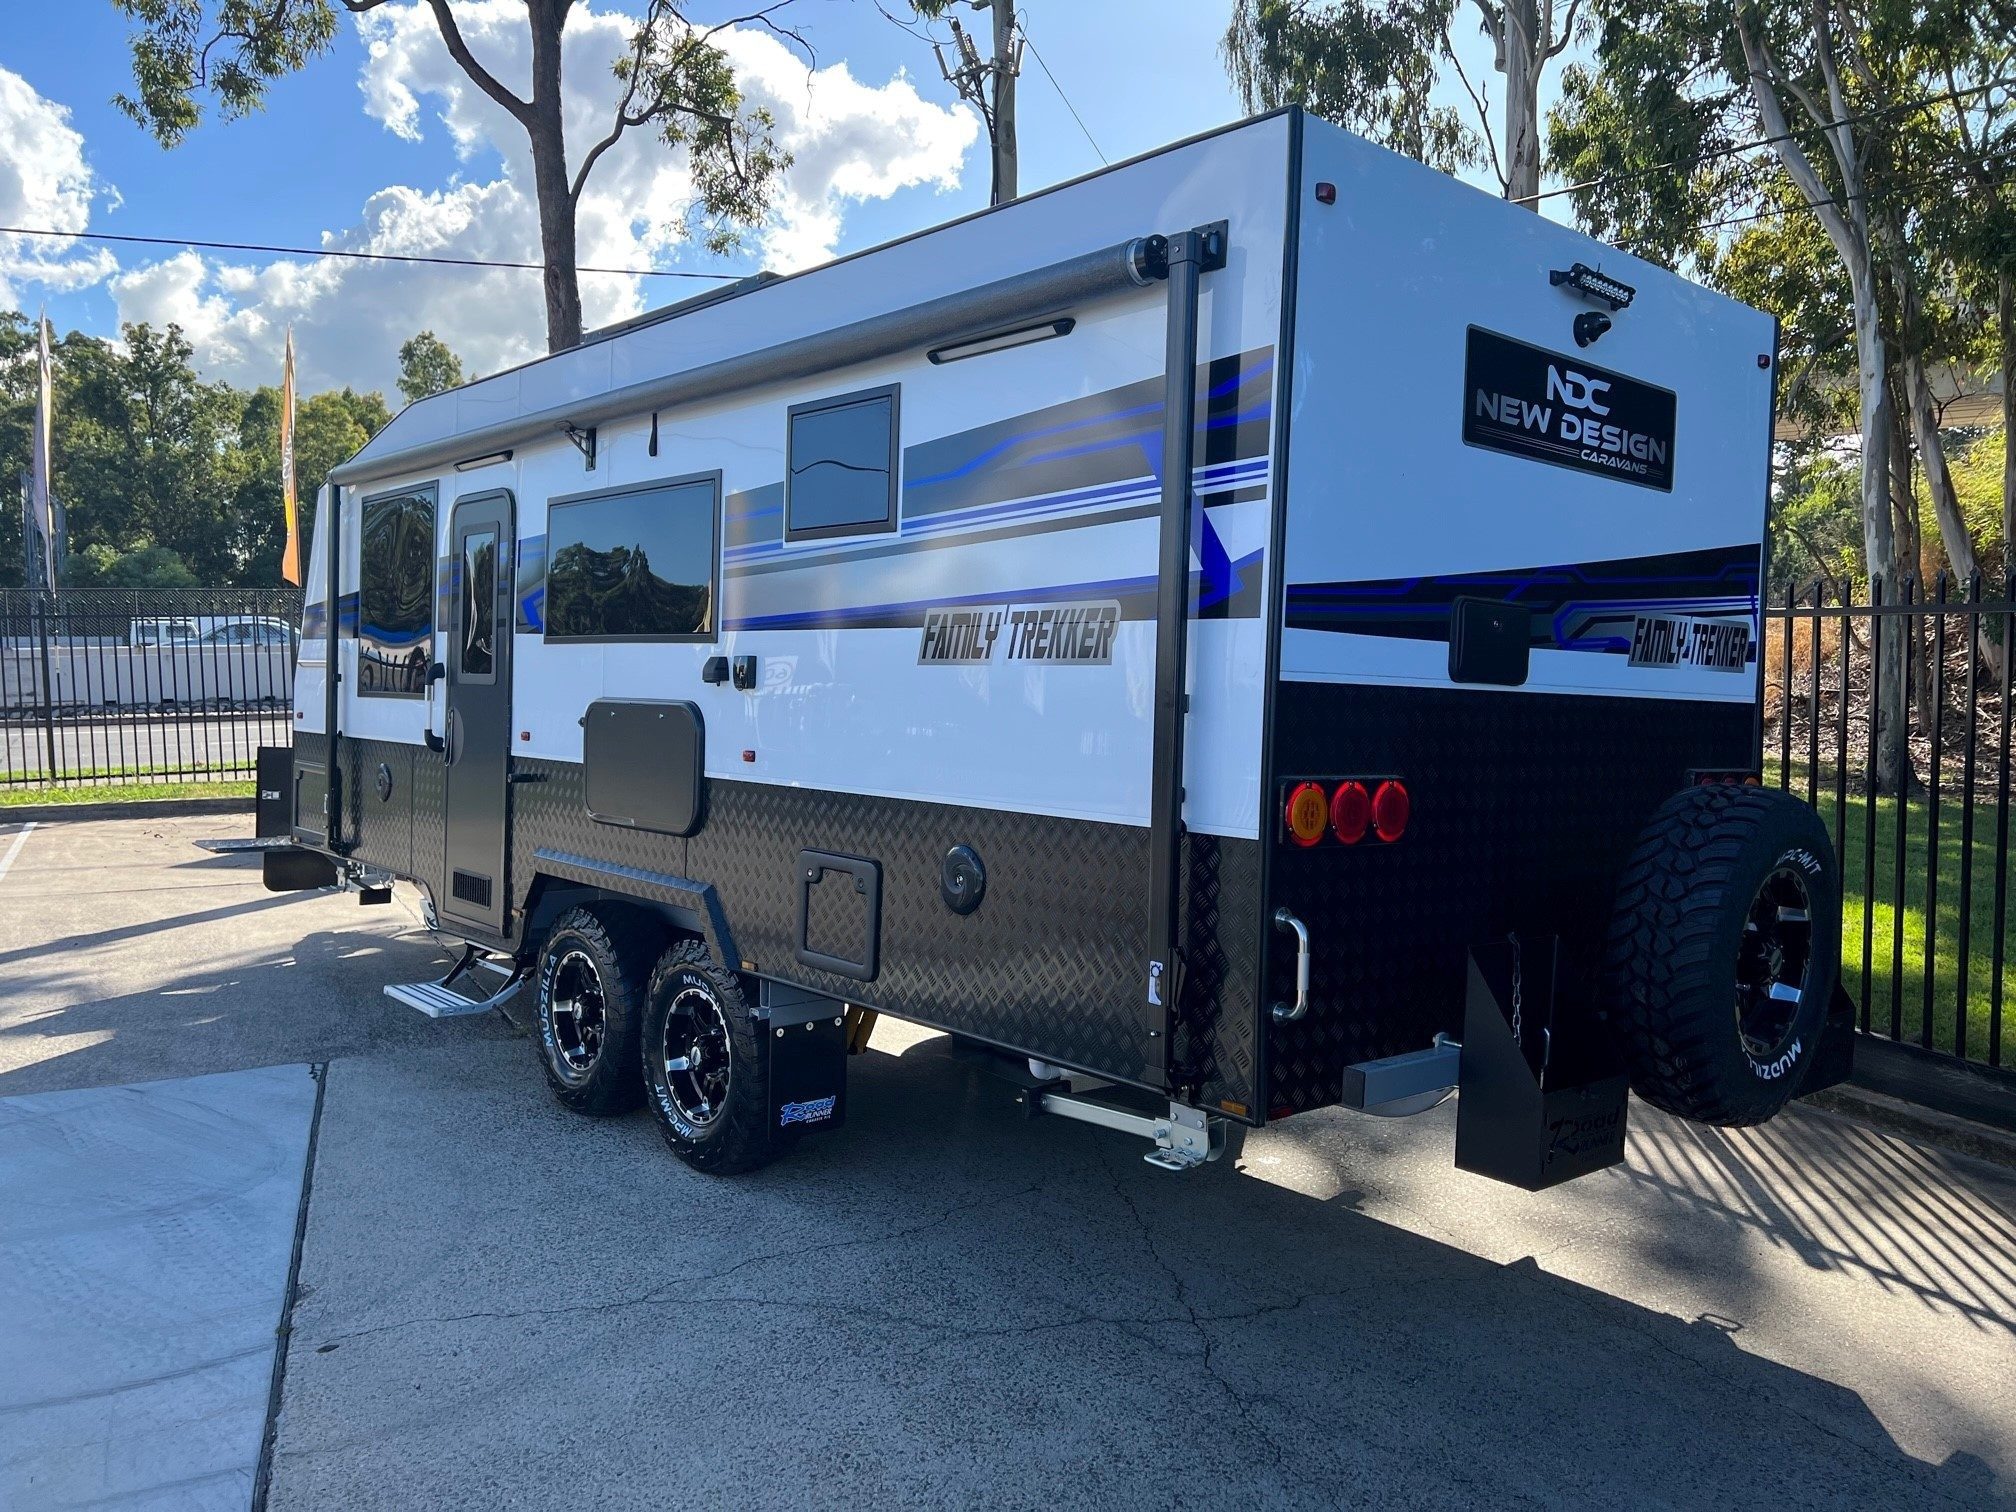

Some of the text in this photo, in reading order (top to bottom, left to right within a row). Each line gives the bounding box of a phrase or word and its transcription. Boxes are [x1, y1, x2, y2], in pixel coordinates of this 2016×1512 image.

[1546, 364, 1612, 416] NDC
[1475, 388, 1667, 465] NEW DESIGN
[1580, 450, 1648, 475] CARAVANS
[921, 606, 1118, 660] FAMILY TREKKER
[1630, 617, 1749, 668] FAMILY TREKKER
[540, 954, 558, 1047] MUDZILLA
[654, 1083, 693, 1138] MPC-M/T
